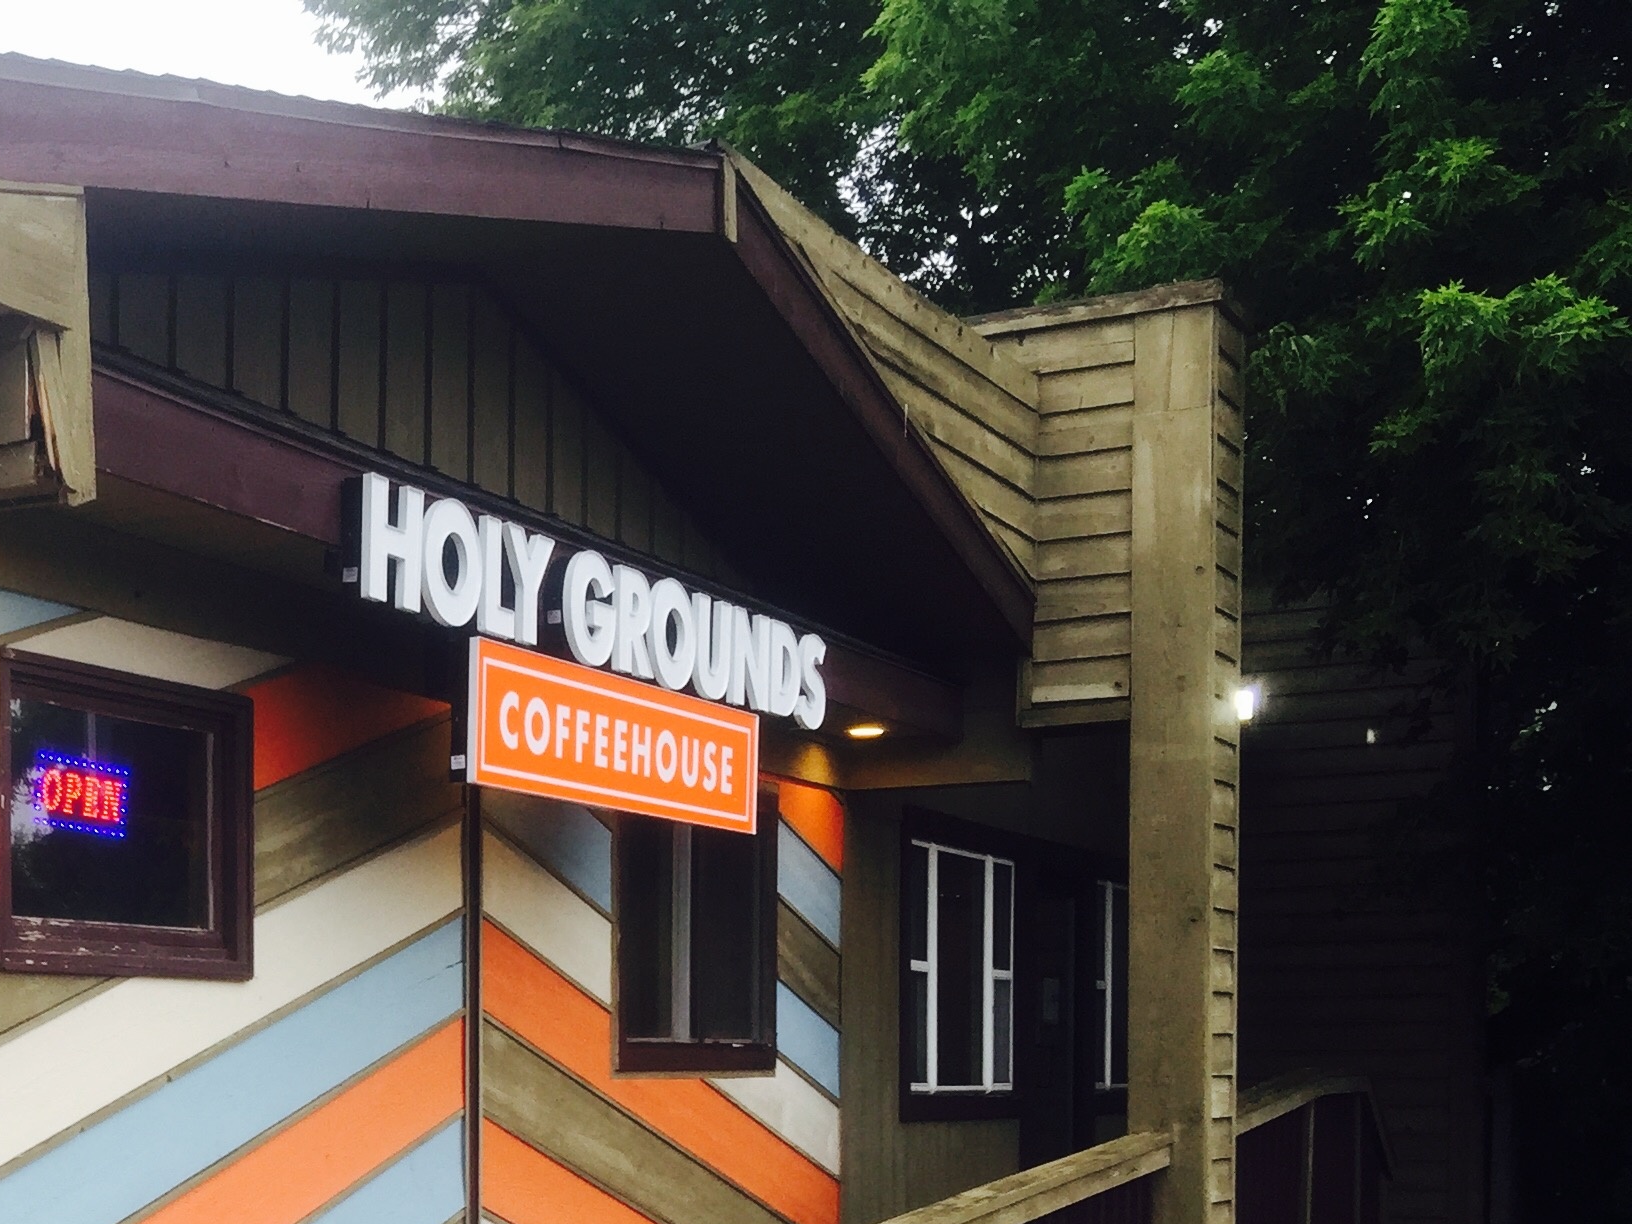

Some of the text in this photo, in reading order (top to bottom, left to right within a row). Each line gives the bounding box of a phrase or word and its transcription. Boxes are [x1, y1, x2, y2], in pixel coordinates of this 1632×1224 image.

[361, 472, 827, 730] HOLY GROUNDS
[42, 768, 122, 822] OPEN
[499, 691, 733, 795] COFFEEHOUSE
